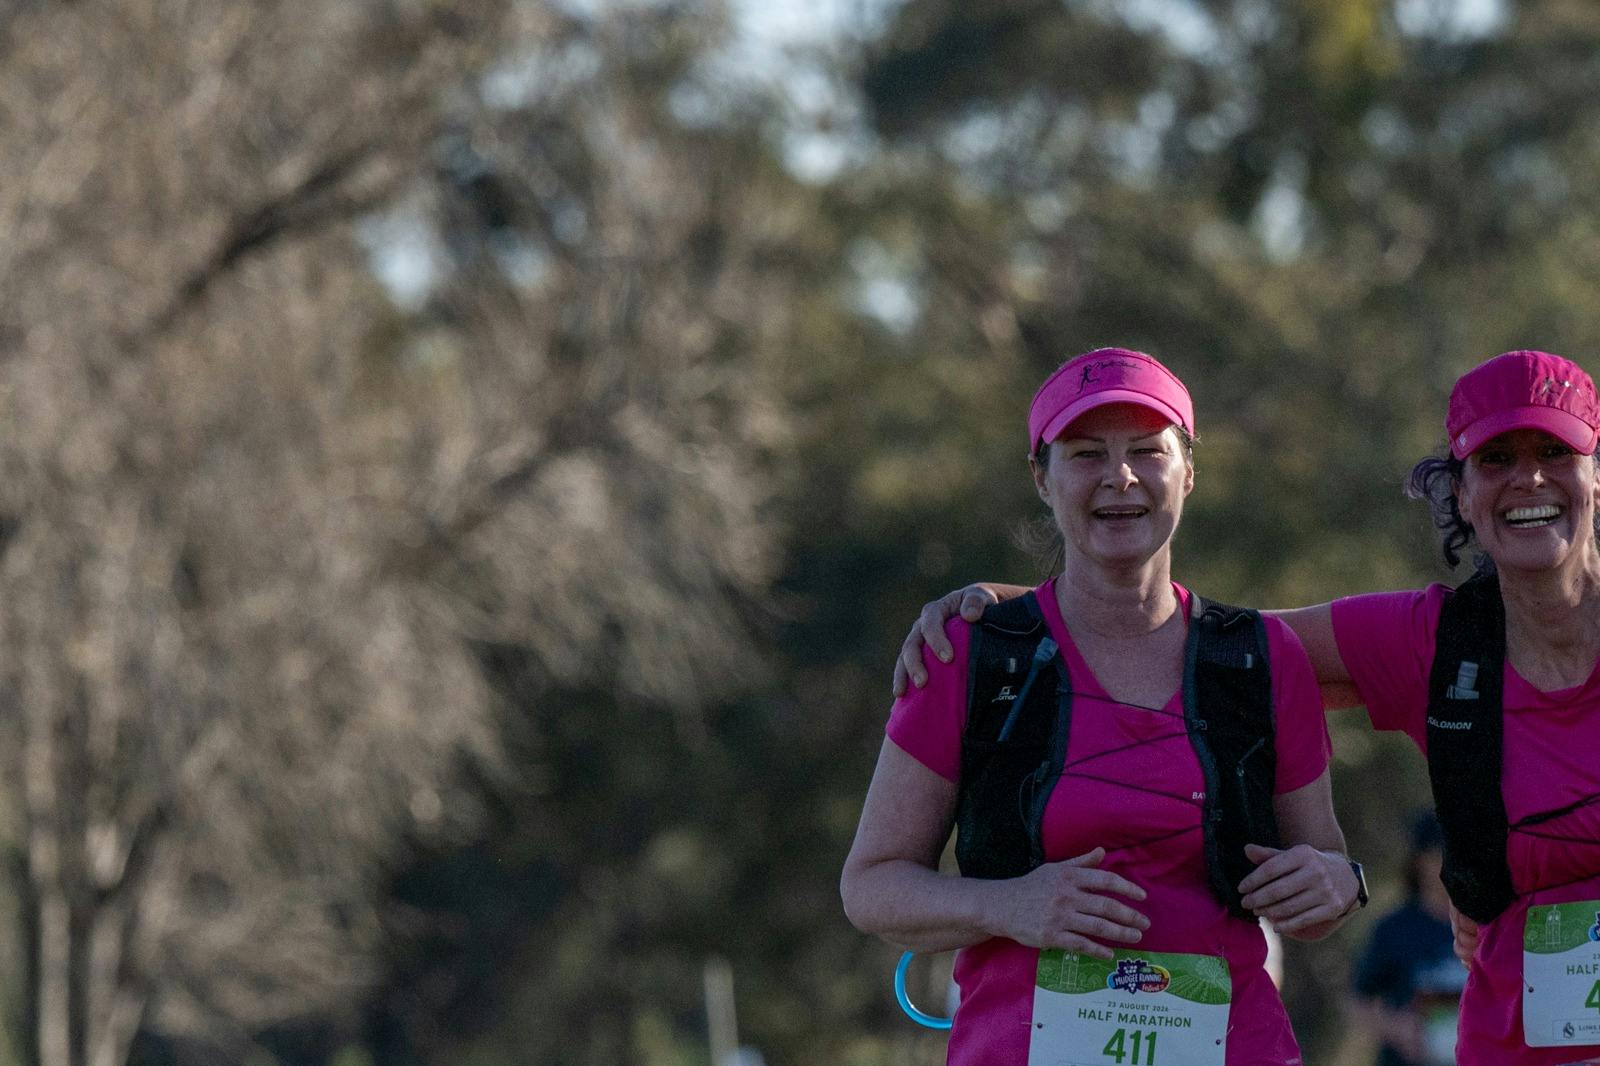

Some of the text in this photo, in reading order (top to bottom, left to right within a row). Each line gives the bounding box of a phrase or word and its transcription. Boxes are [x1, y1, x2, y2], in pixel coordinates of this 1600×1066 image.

[1566, 963, 1600, 976] HALF
[1115, 973, 1138, 986] MUDGEE
[1119, 1002, 1150, 1011] AUGUST
[1078, 1008, 1192, 1028] HALF MARATHON
[1102, 1028, 1158, 1066] 411
